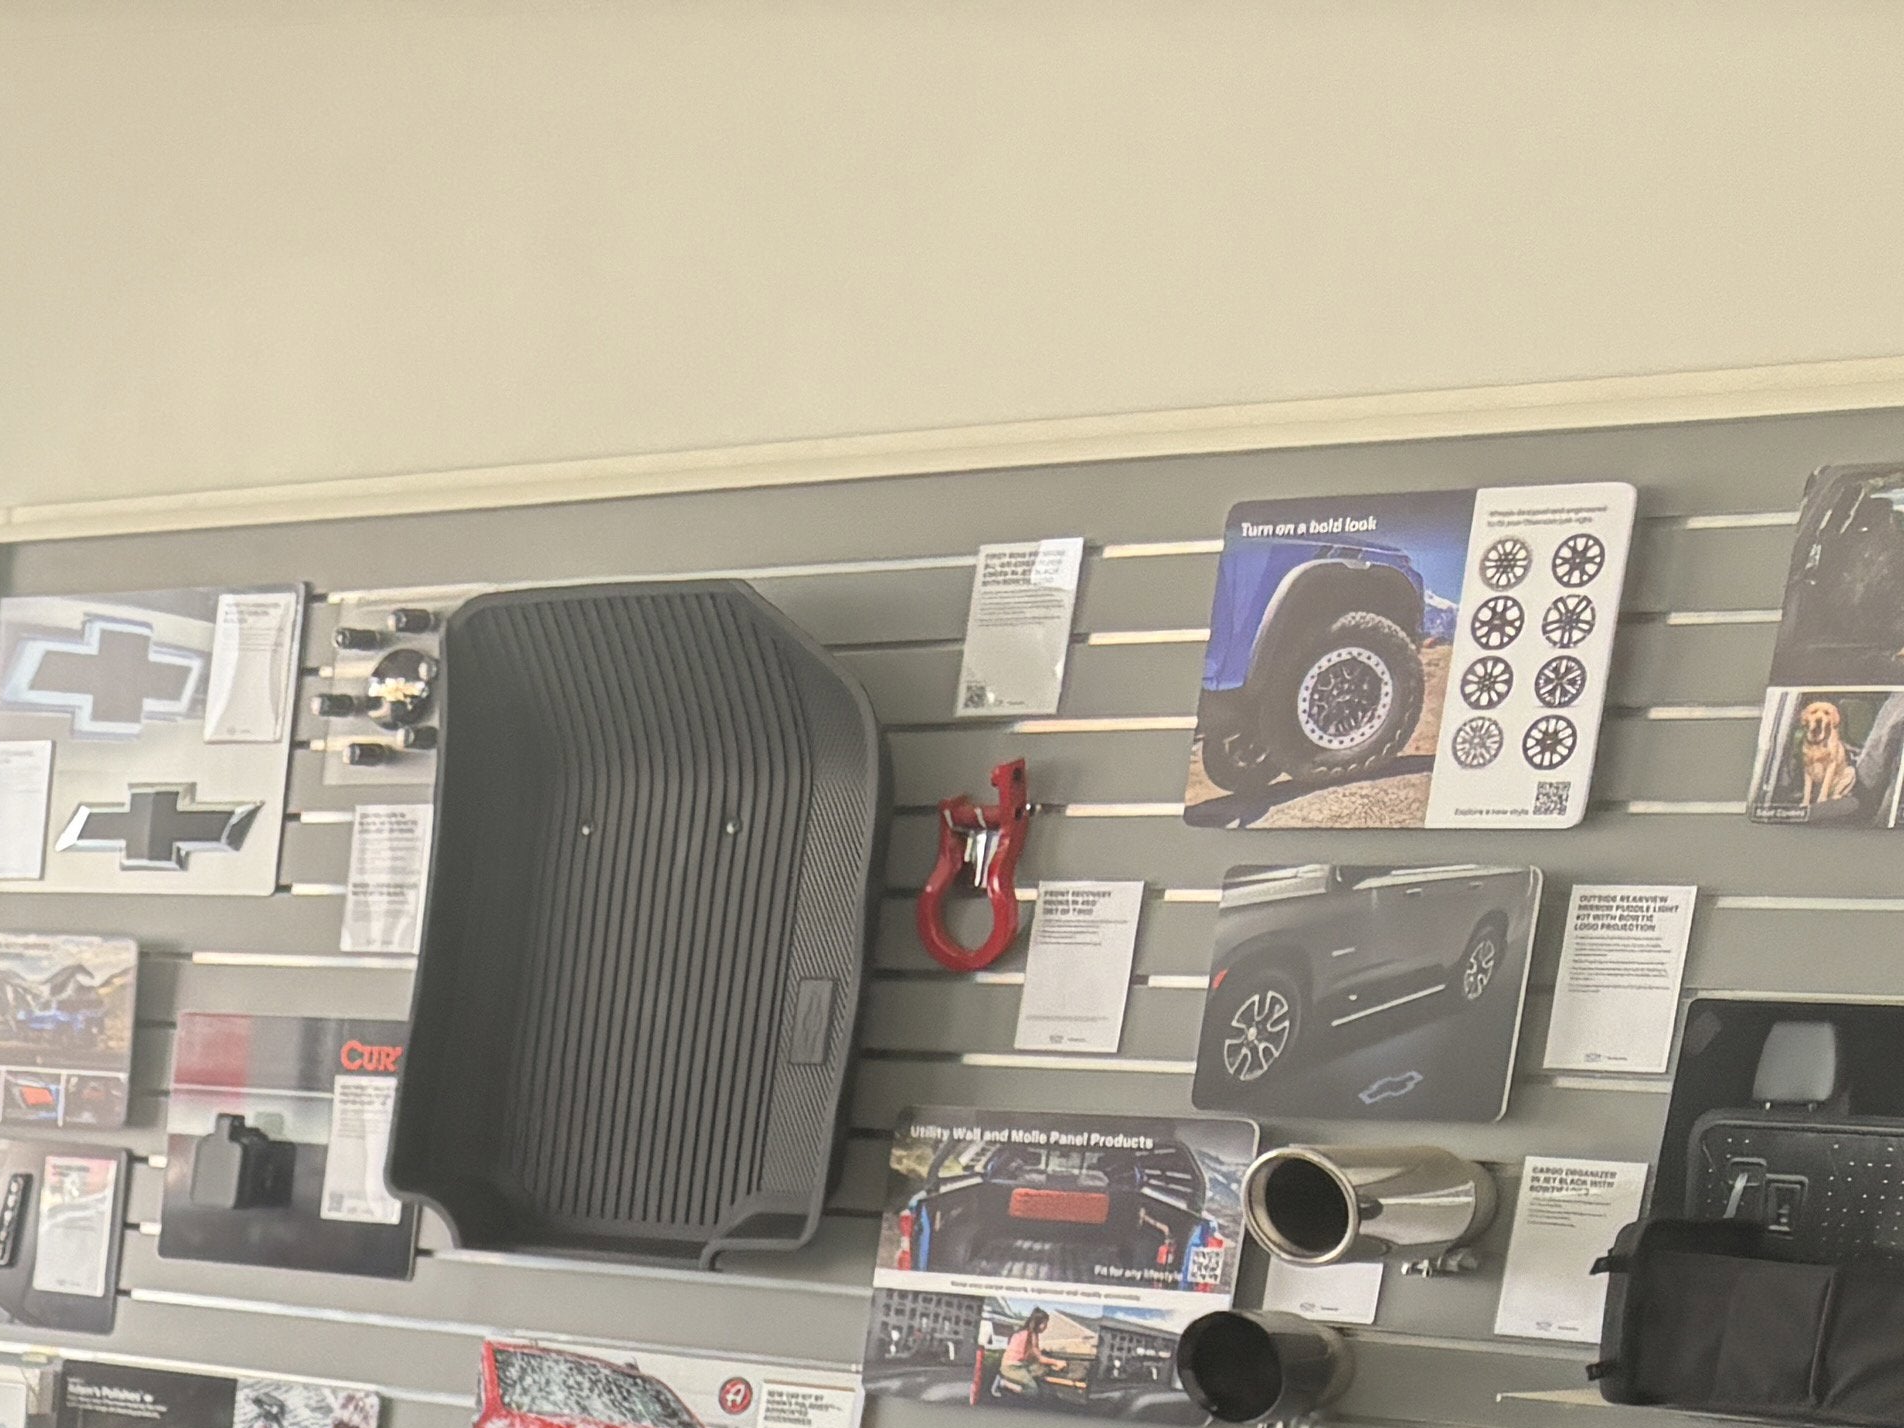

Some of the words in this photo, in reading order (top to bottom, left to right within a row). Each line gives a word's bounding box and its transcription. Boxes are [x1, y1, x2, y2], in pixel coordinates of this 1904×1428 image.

[1242, 522, 1273, 537] Turn
[1275, 523, 1294, 536] on
[1297, 523, 1307, 535] a
[1309, 517, 1342, 534] bold
[1345, 516, 1377, 532] look
[1580, 895, 1618, 903] OUTSIDE
[1619, 895, 1669, 903] REARVIEW
[1615, 905, 1650, 913] PUDDLE
[1652, 905, 1679, 913] LIGHT
[1618, 914, 1654, 922] BOWTIE
[1574, 923, 1599, 931] LOGO
[1600, 923, 1656, 932] PROJECTION
[340, 1040, 405, 1073] CUR
[910, 1125, 950, 1141] Utility
[952, 1127, 981, 1141] Wall
[983, 1129, 1009, 1142] and
[1011, 1129, 1047, 1144] Molle
[1050, 1131, 1088, 1146] Panel
[1090, 1133, 1154, 1149] Products
[1532, 1166, 1564, 1175] CARGO
[1565, 1168, 1618, 1179] ORGANIZER
[1559, 1177, 1588, 1186] BLACK
[1094, 1265, 1107, 1276] Fit
[1109, 1266, 1123, 1277] for
[1124, 1269, 1142, 1281] any
